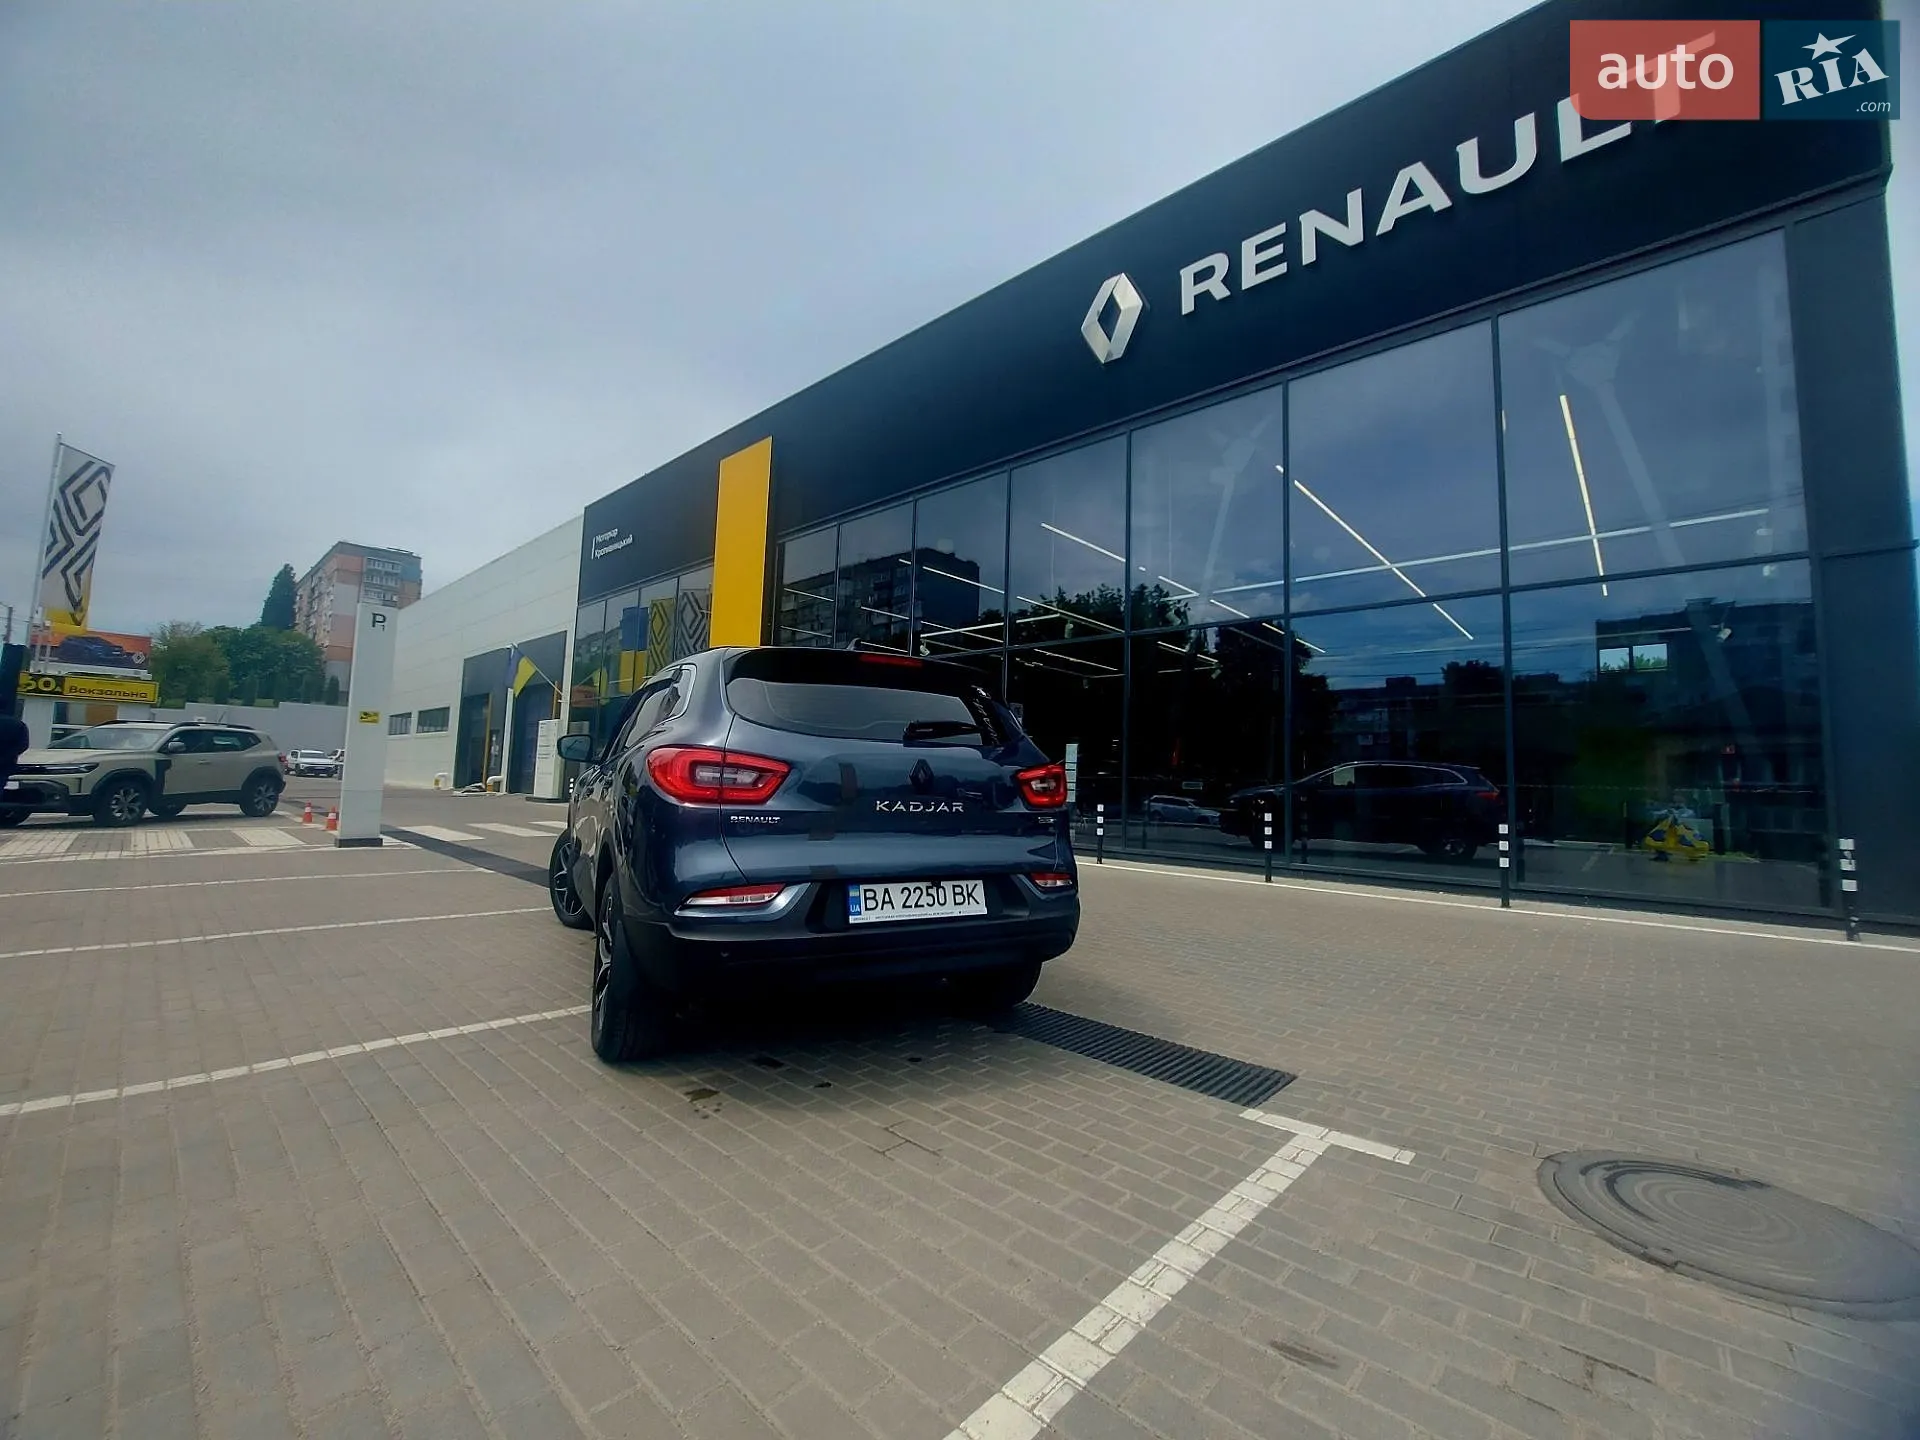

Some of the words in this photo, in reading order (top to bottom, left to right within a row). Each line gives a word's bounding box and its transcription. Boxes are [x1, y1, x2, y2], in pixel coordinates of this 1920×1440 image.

[1180, 31, 1716, 316] RENAULT
[68, 685, 149, 699] Вокзальна
[875, 800, 965, 813] KADJAR
[730, 815, 781, 824] RENAULT
[849, 903, 861, 913] UA
[863, 887, 896, 912] BA
[900, 885, 948, 909] 2250
[951, 883, 981, 906] BK
